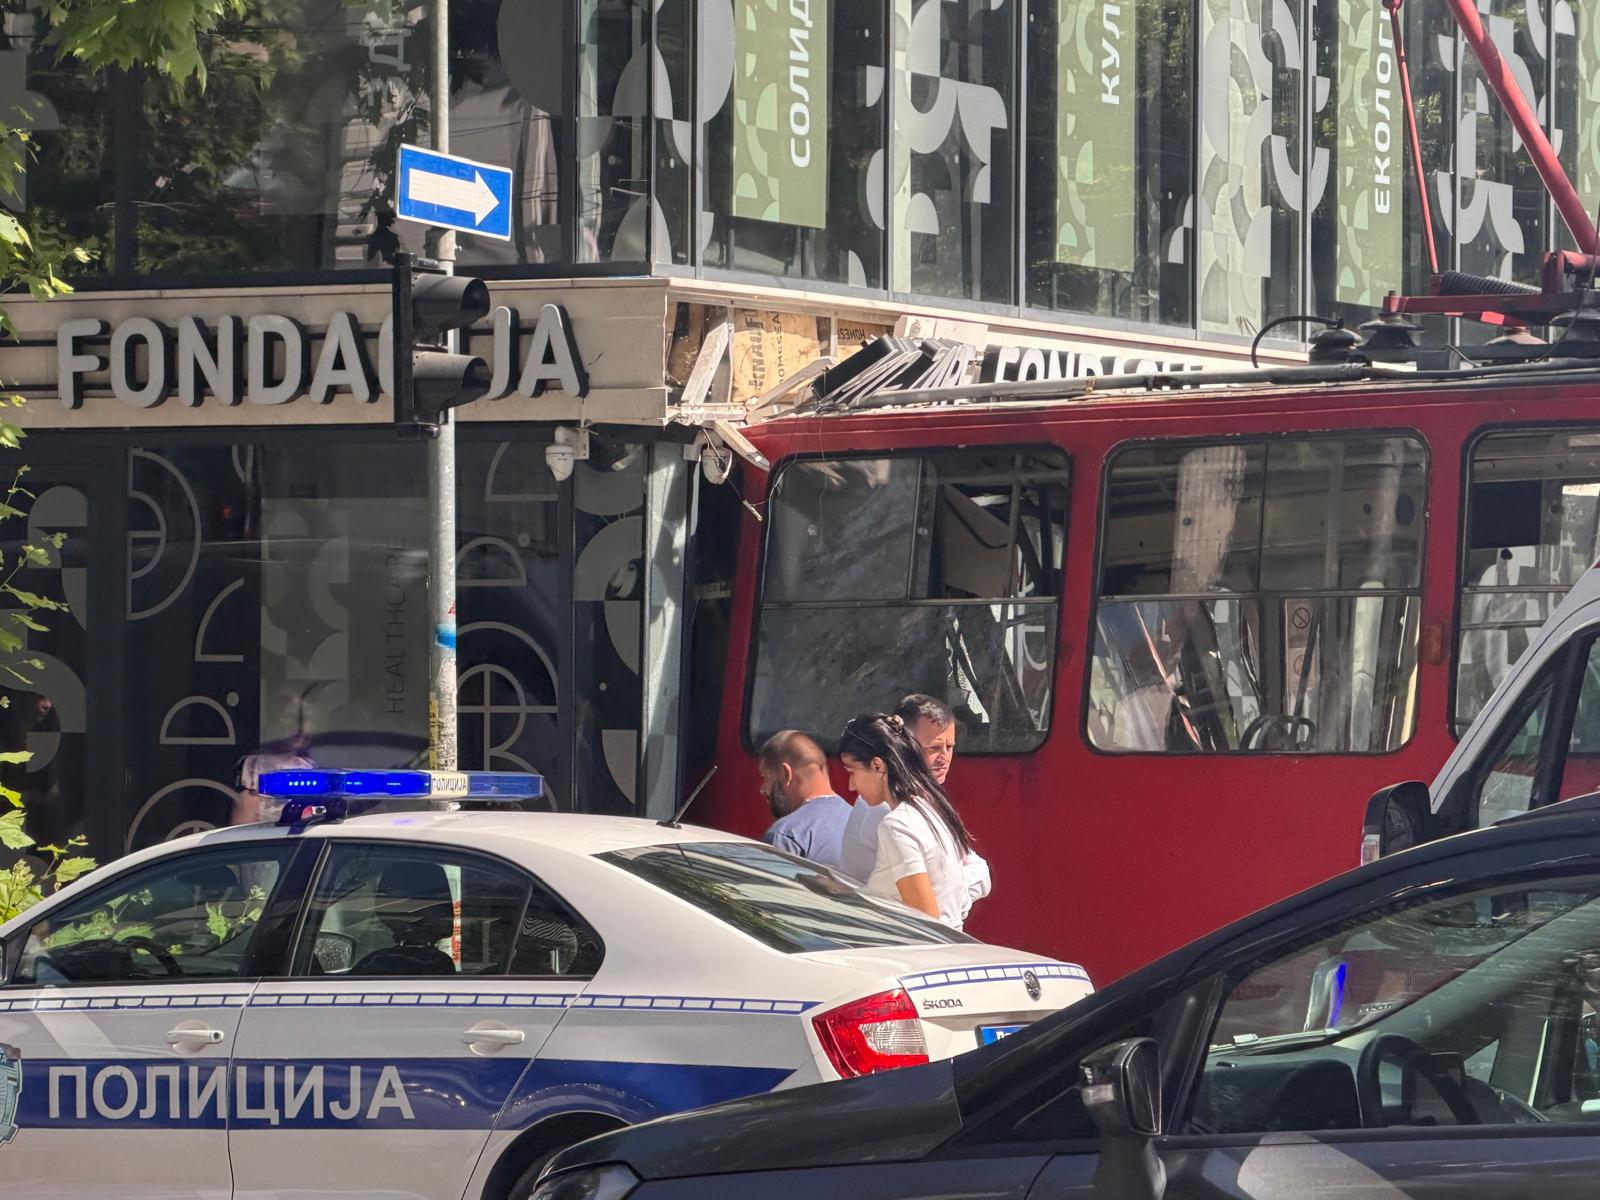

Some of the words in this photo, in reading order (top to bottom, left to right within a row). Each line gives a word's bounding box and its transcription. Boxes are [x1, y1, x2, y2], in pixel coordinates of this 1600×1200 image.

[789, 0, 813, 168] СОЛИД
[1102, 3, 1121, 105] КУЛ
[57, 303, 585, 409] FONDAJA
[923, 998, 963, 1010] ŠKODA
[48, 1065, 416, 1125] ПОЛИЦИЈА
